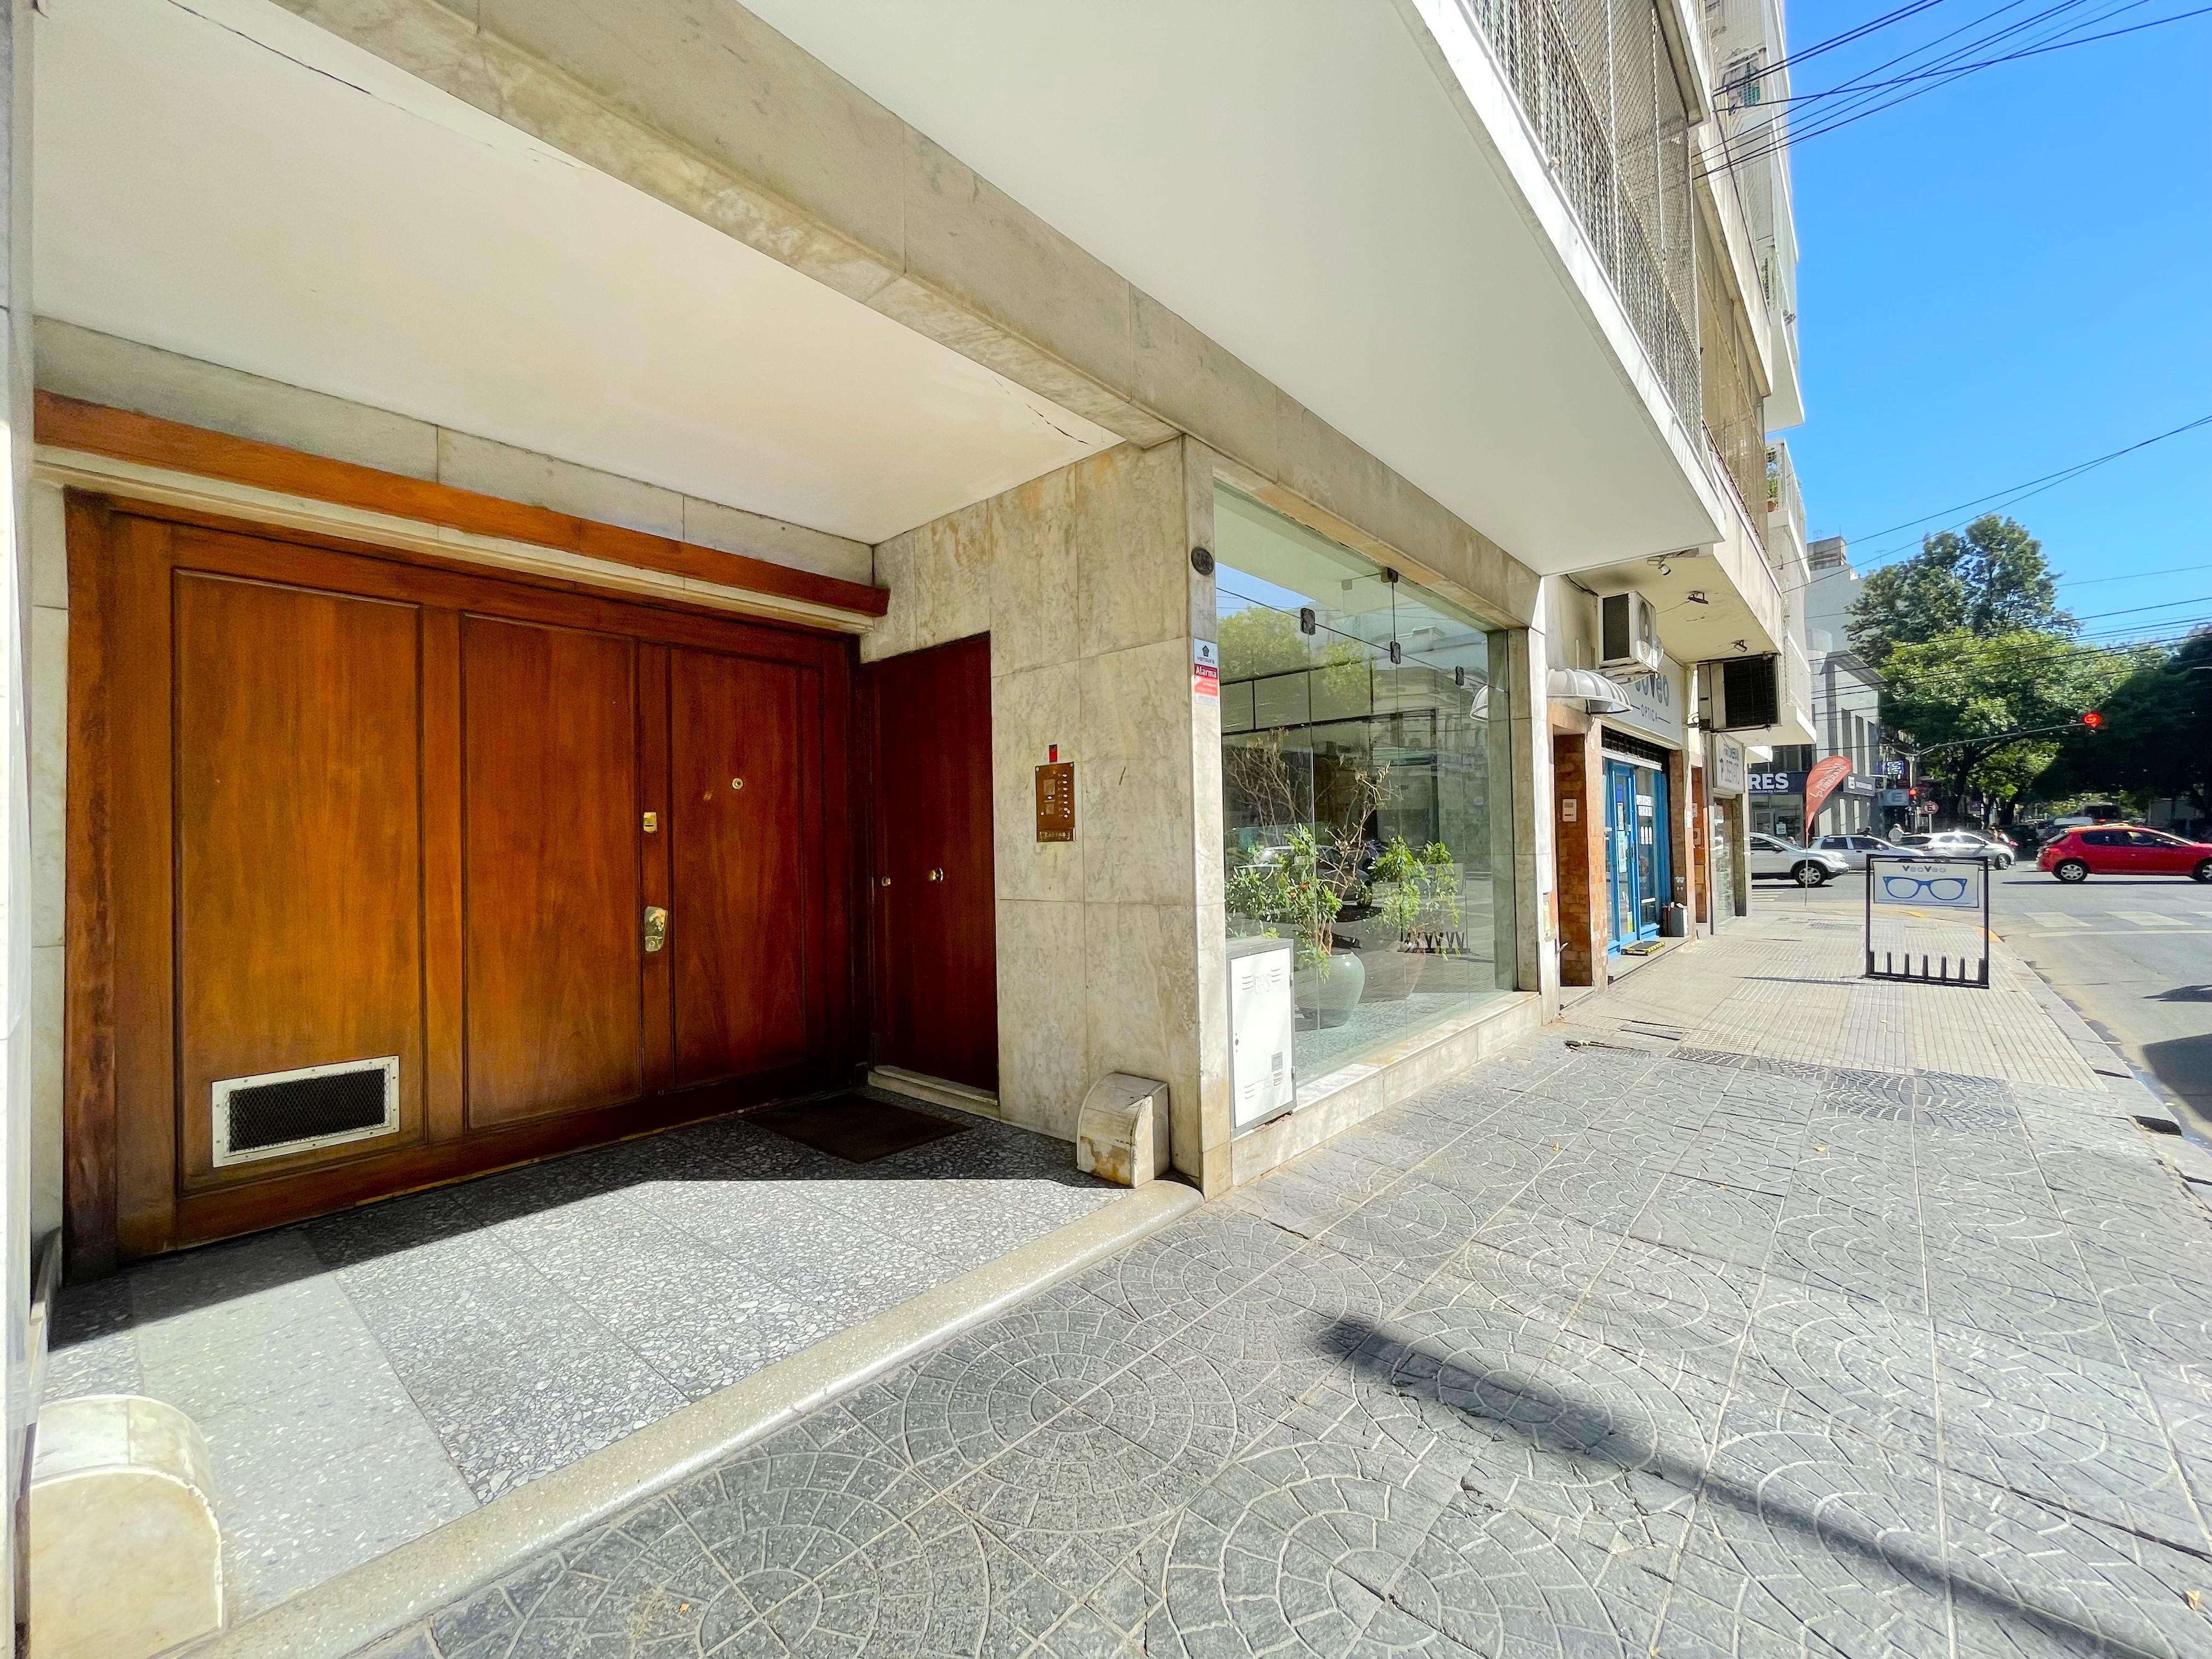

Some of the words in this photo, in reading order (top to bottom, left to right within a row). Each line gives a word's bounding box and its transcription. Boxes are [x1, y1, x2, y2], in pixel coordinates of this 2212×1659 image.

[1196, 666, 1217, 678] Alarma
[1747, 772, 1788, 789] RES
[1902, 865, 1946, 873] VeoVeo
